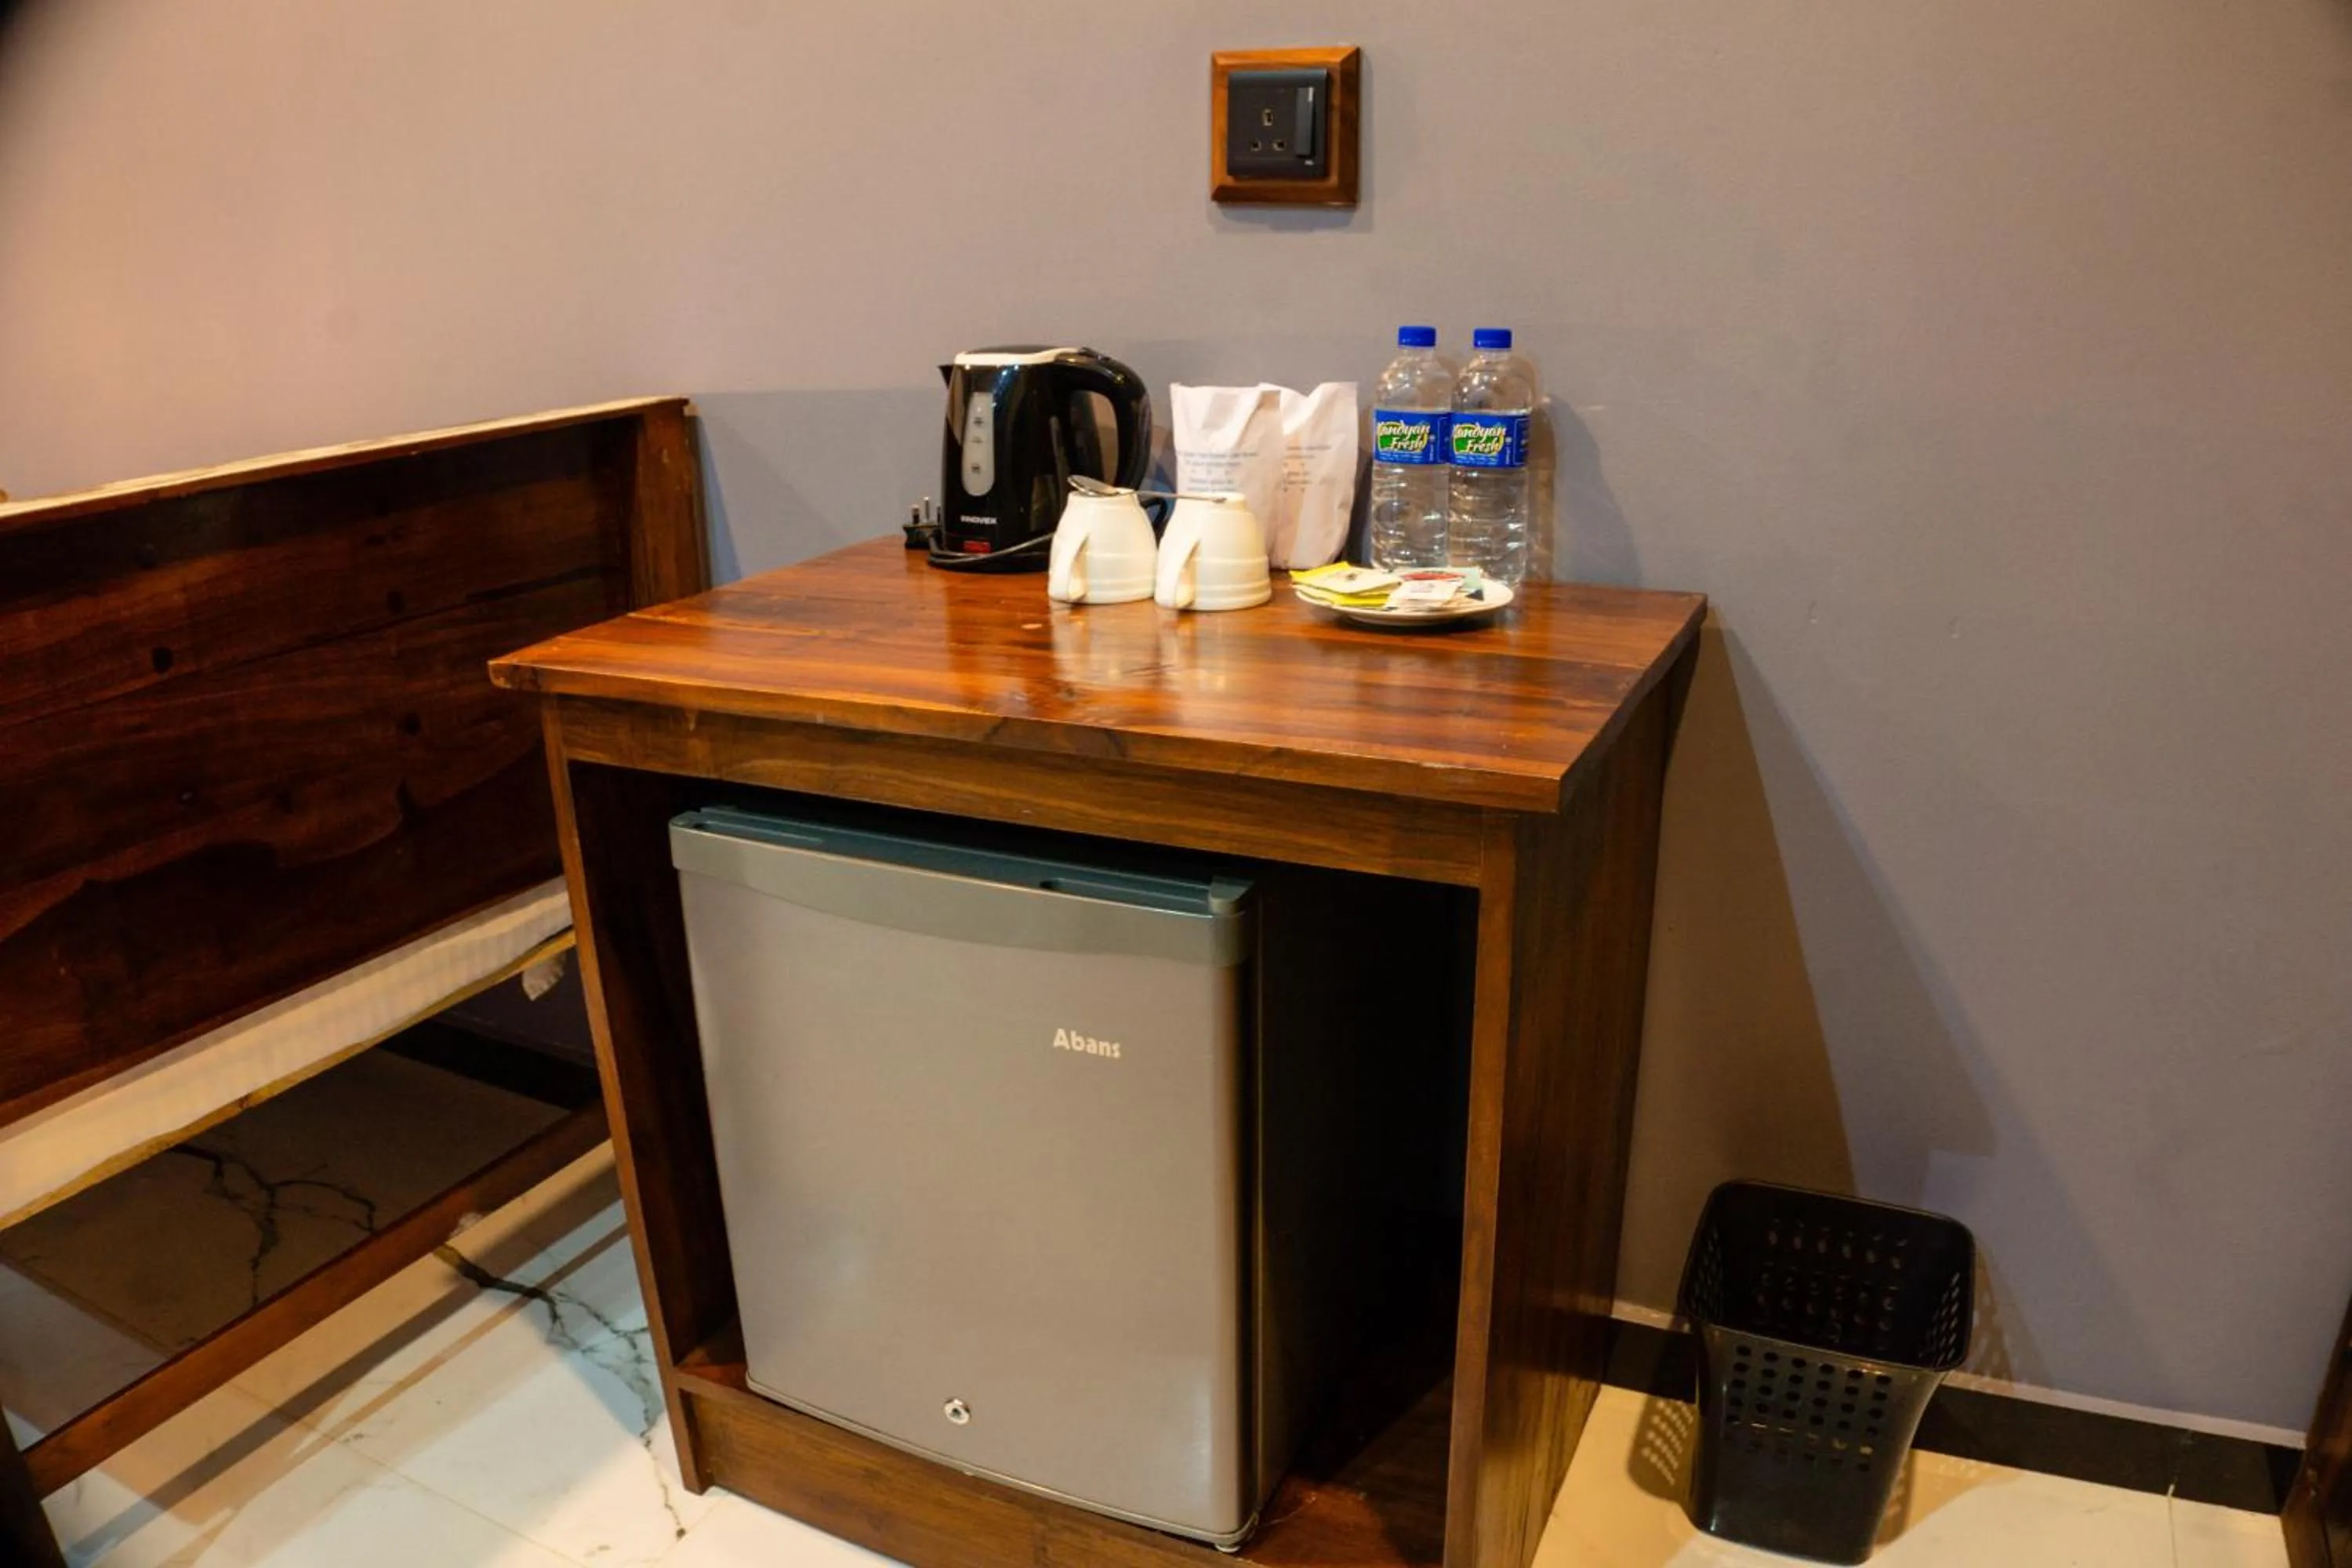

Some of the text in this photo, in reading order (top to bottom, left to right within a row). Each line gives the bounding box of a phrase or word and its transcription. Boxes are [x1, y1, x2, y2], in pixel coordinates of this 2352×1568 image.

[1391, 435, 1424, 452] Fresh
[1467, 437, 1501, 453] Fresh
[1053, 1028, 1121, 1058] Abans
